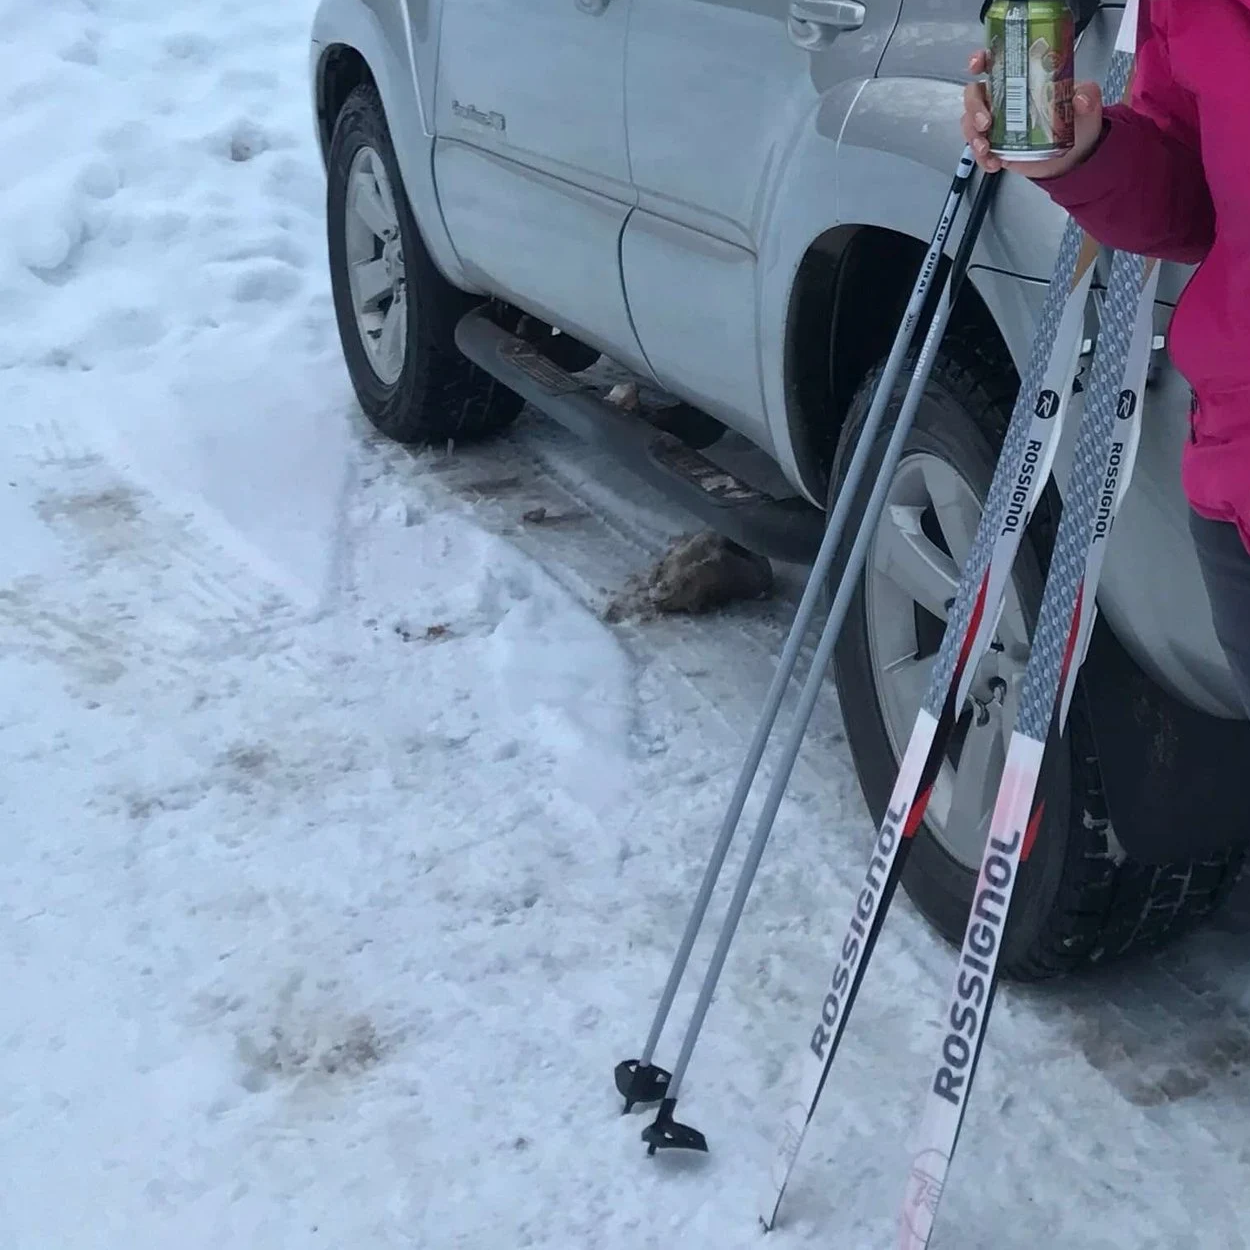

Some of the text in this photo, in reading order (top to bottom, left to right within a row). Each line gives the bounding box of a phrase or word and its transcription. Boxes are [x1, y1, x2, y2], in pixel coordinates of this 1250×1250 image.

[1001, 440, 1042, 536] ROSSIGNOL
[1092, 442, 1124, 544] ROSSIGNOL
[810, 801, 907, 1062] ROSSIGNOL
[932, 829, 1021, 1106] ROSSIGNOL
